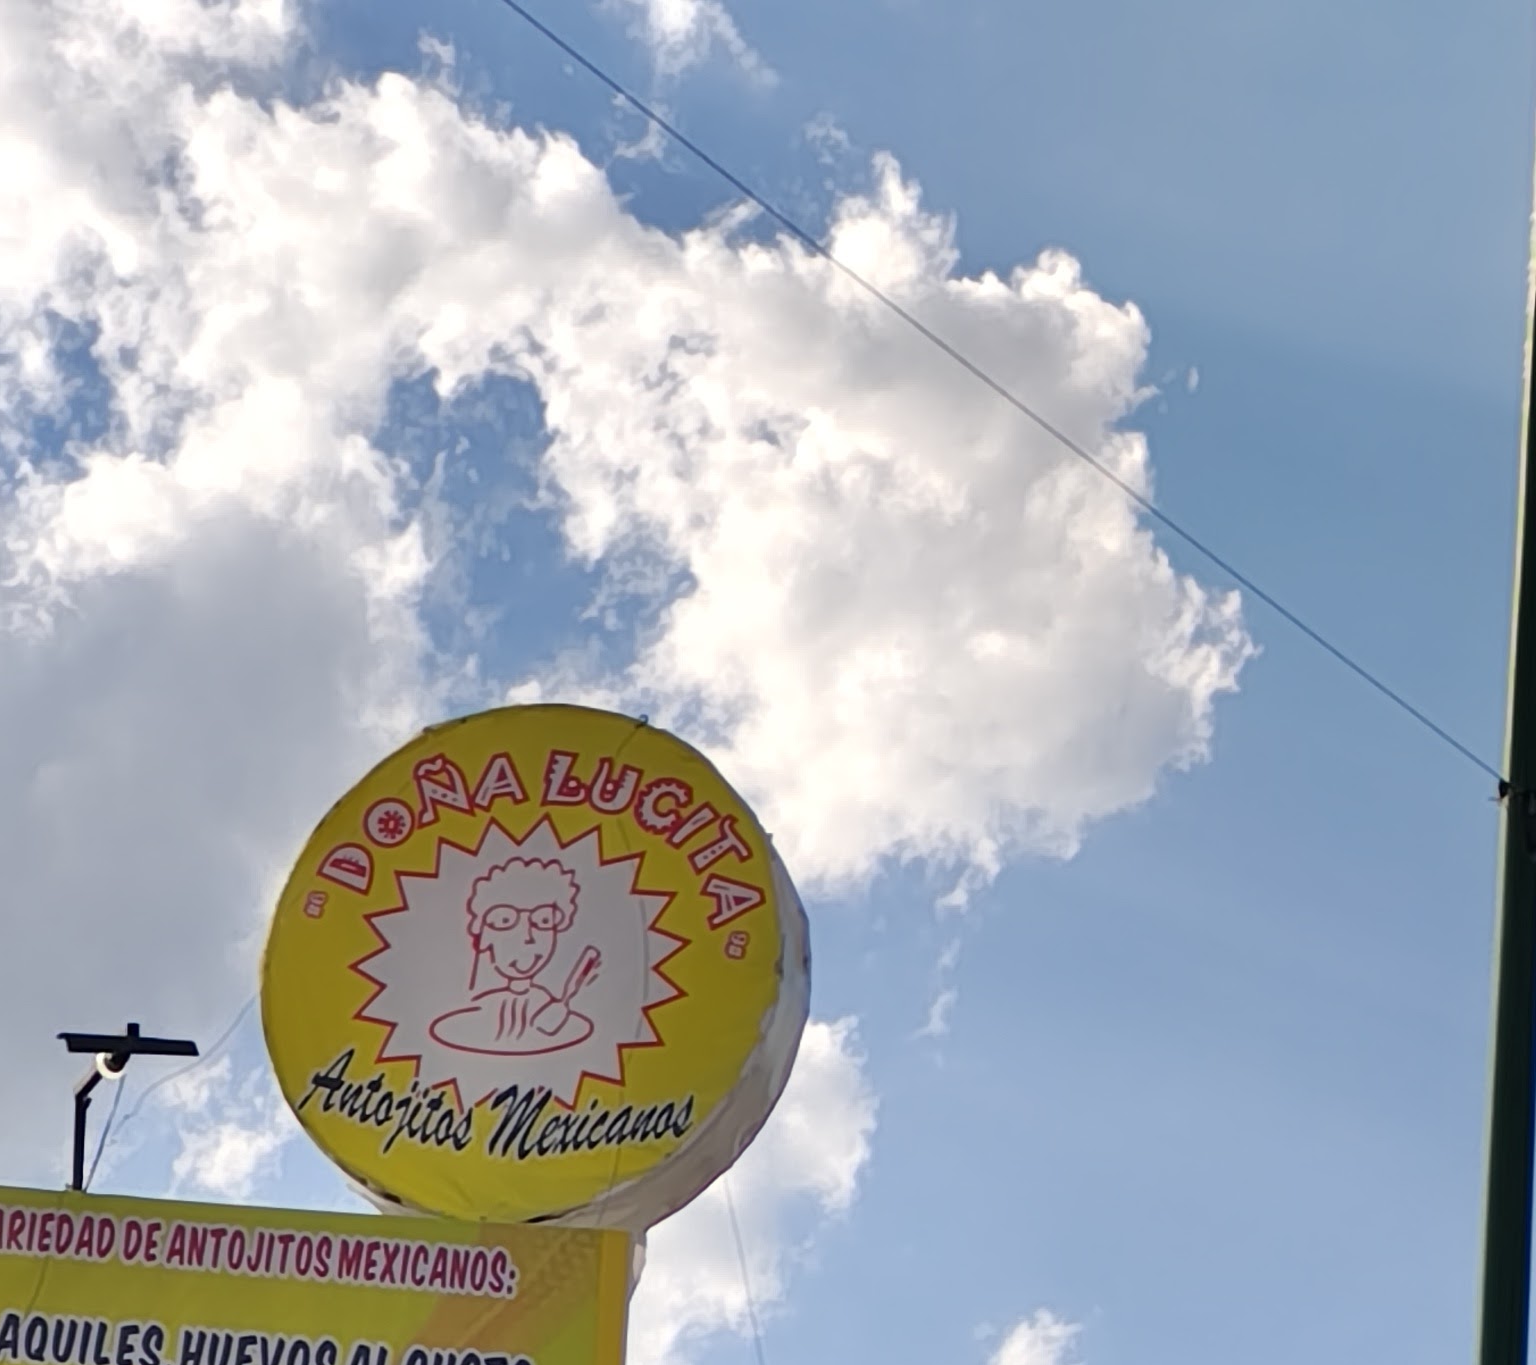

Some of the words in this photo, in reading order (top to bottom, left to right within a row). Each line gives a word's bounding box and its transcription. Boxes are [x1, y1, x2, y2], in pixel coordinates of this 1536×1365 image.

[299, 1048, 473, 1154] Antojitos
[488, 1084, 695, 1160] Mexicanos
[123, 1218, 162, 1262] DE
[166, 1223, 332, 1278] ANTOJITOS
[337, 1239, 517, 1295] MEXICANOS:
